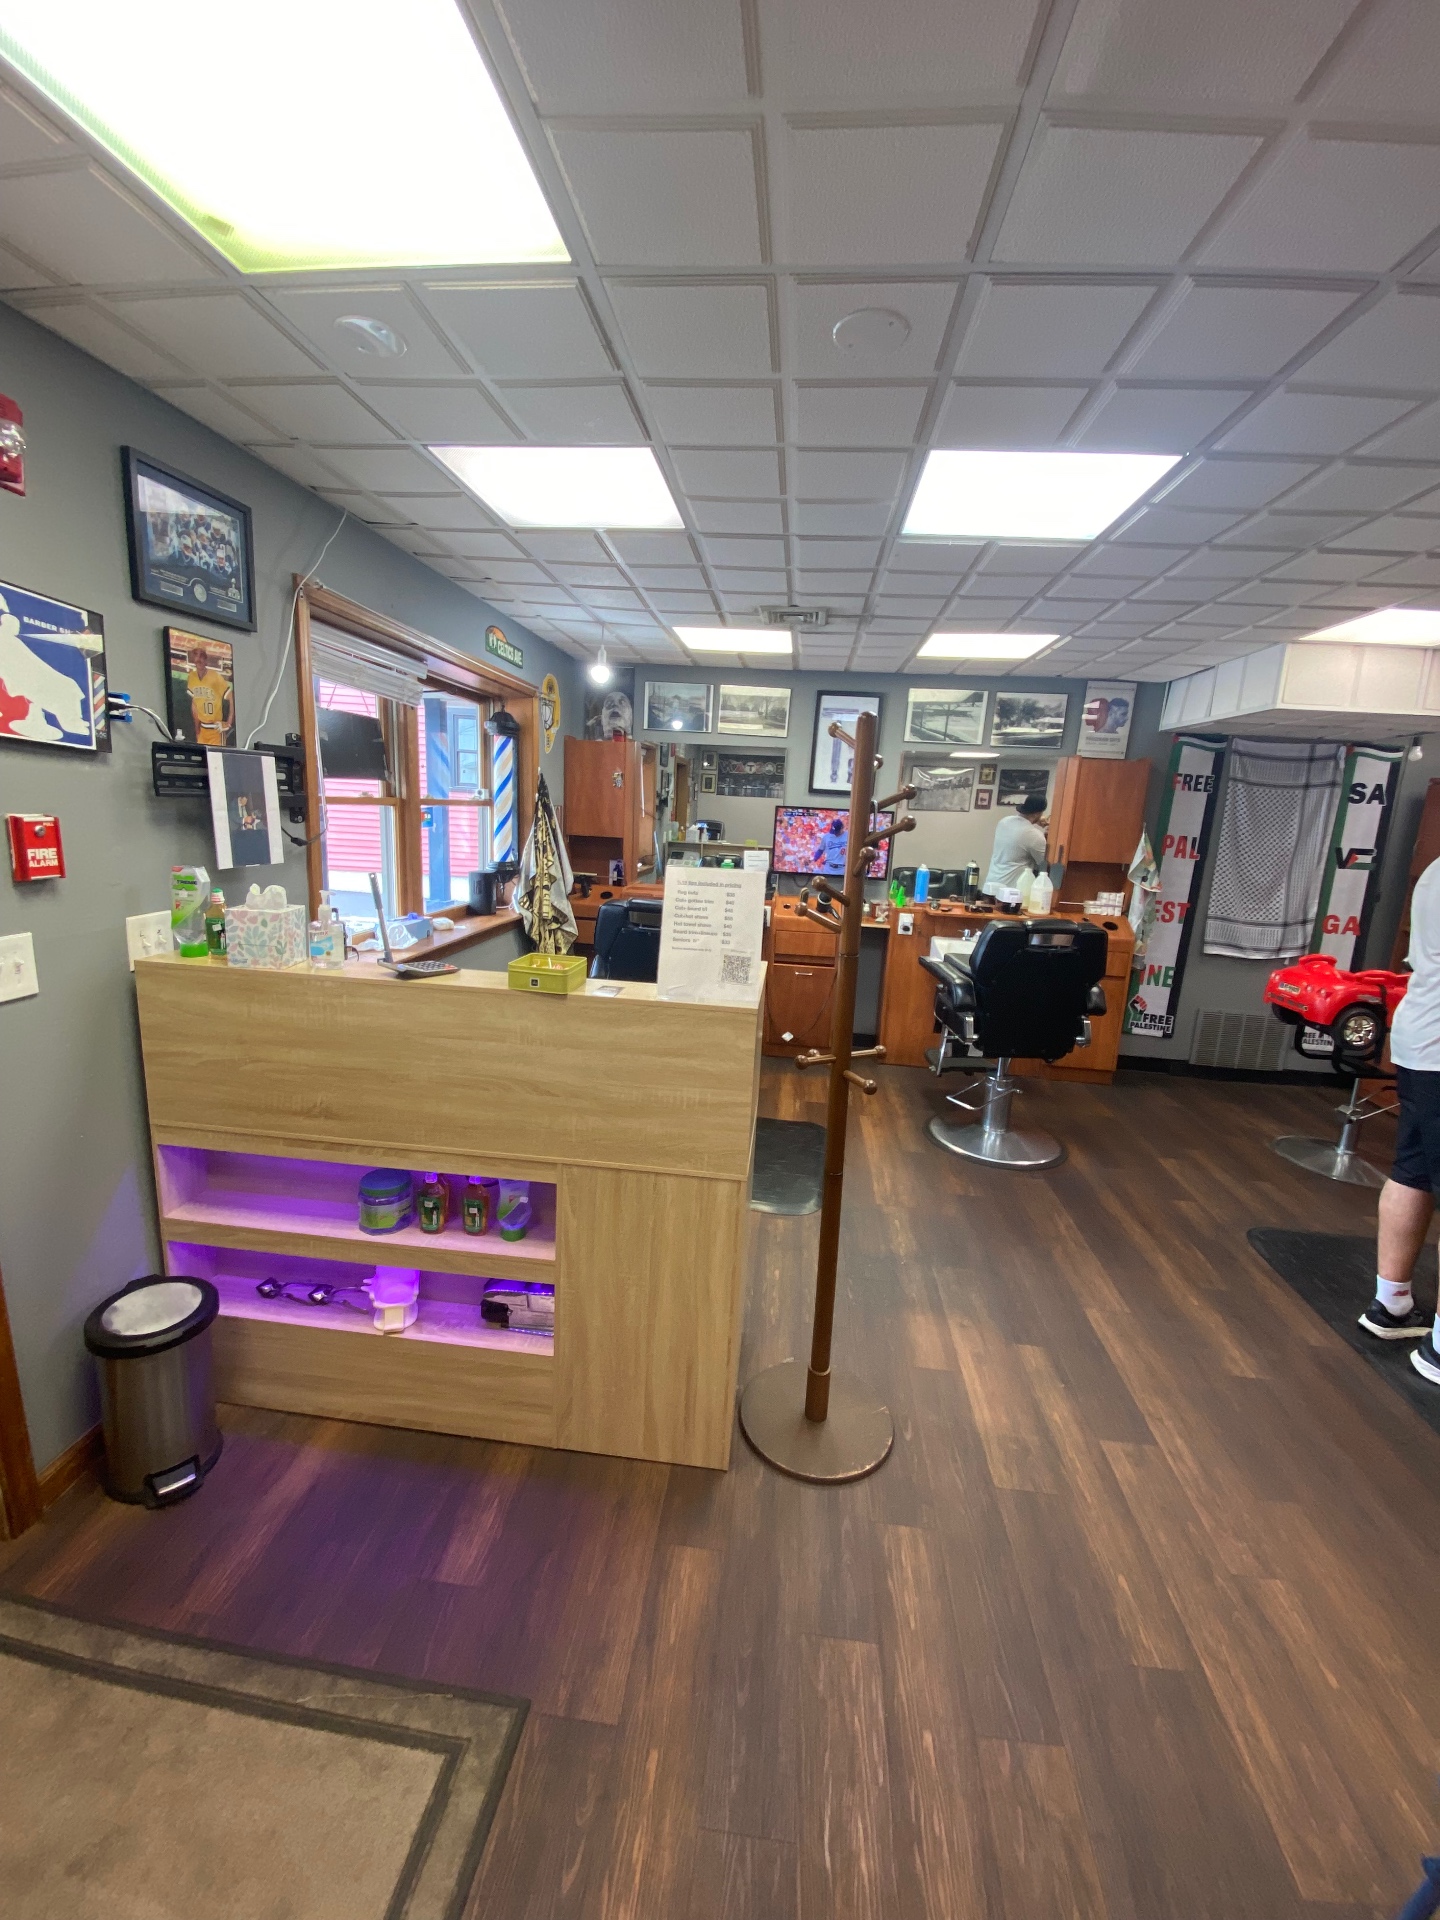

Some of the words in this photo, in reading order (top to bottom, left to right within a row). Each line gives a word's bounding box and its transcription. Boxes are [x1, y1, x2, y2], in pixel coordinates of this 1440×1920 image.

[23, 616, 57, 632] BARBER
[203, 702, 214, 715] 10
[1171, 772, 1215, 794] FREE
[1348, 782, 1386, 806] SA
[27, 848, 57, 861] FIRE
[1161, 834, 1200, 861] PAL
[29, 859, 58, 868] ALARM
[1322, 914, 1361, 936] GA
[1139, 964, 1176, 988] INE
[1130, 1021, 1172, 1033] PALESTINE
[1142, 1013, 1173, 1026] FREE
